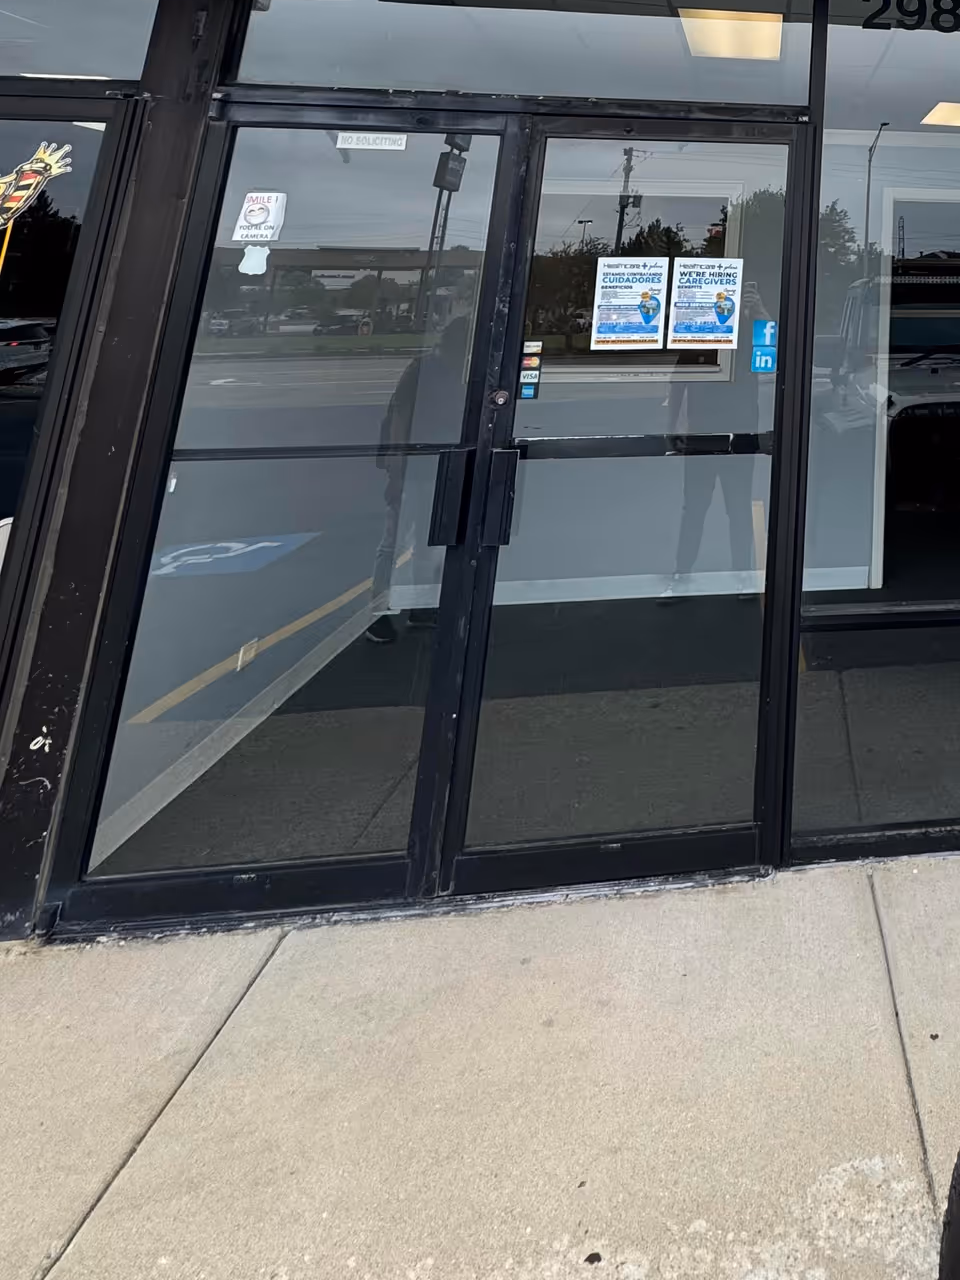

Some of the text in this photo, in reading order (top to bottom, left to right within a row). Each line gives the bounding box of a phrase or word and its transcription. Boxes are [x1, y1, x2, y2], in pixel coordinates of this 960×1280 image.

[341, 135, 403, 147] NO SOLICITING
[246, 196, 272, 204] SMILE
[708, 271, 738, 279] HIRING
[602, 276, 662, 284] CUIDADORES
[678, 277, 737, 286] CAREGIVERS
[523, 372, 538, 380] VISA
